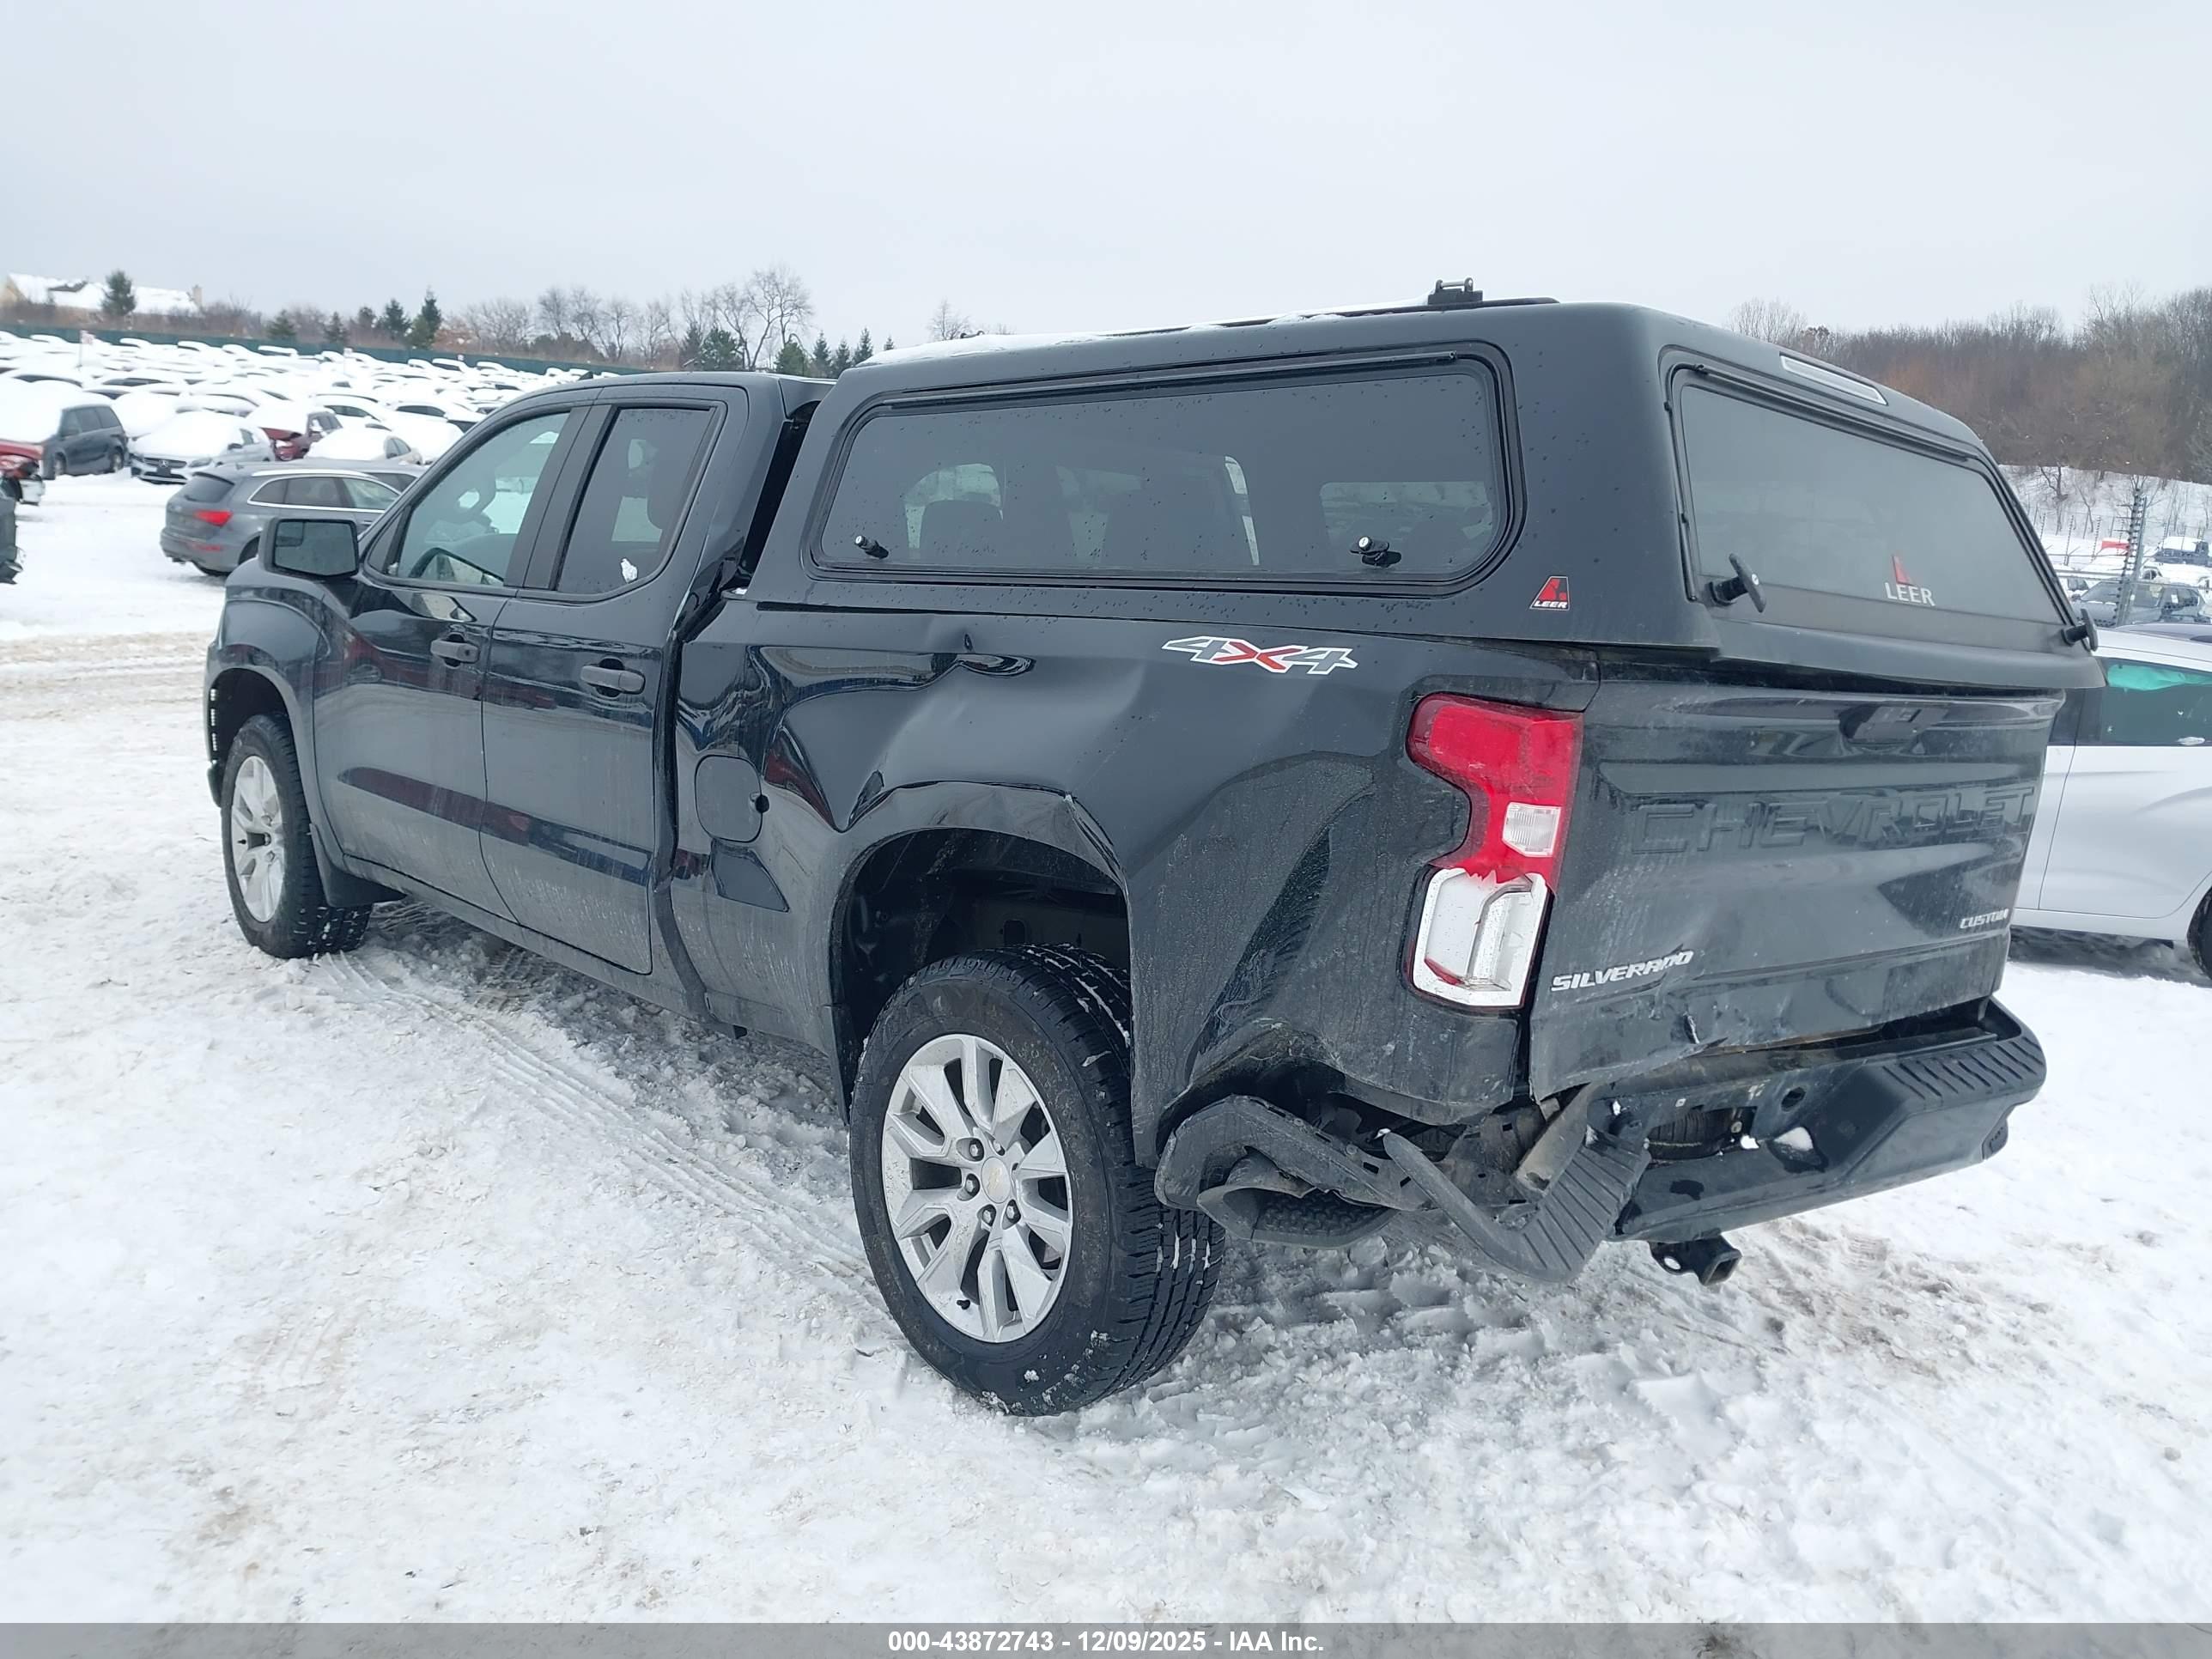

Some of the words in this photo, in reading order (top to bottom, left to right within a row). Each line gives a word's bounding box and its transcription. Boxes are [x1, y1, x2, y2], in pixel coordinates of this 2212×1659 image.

[1534, 599, 1568, 610] LEER
[1884, 581, 1936, 607] LEER
[1630, 786, 2035, 855] CHEVROLET
